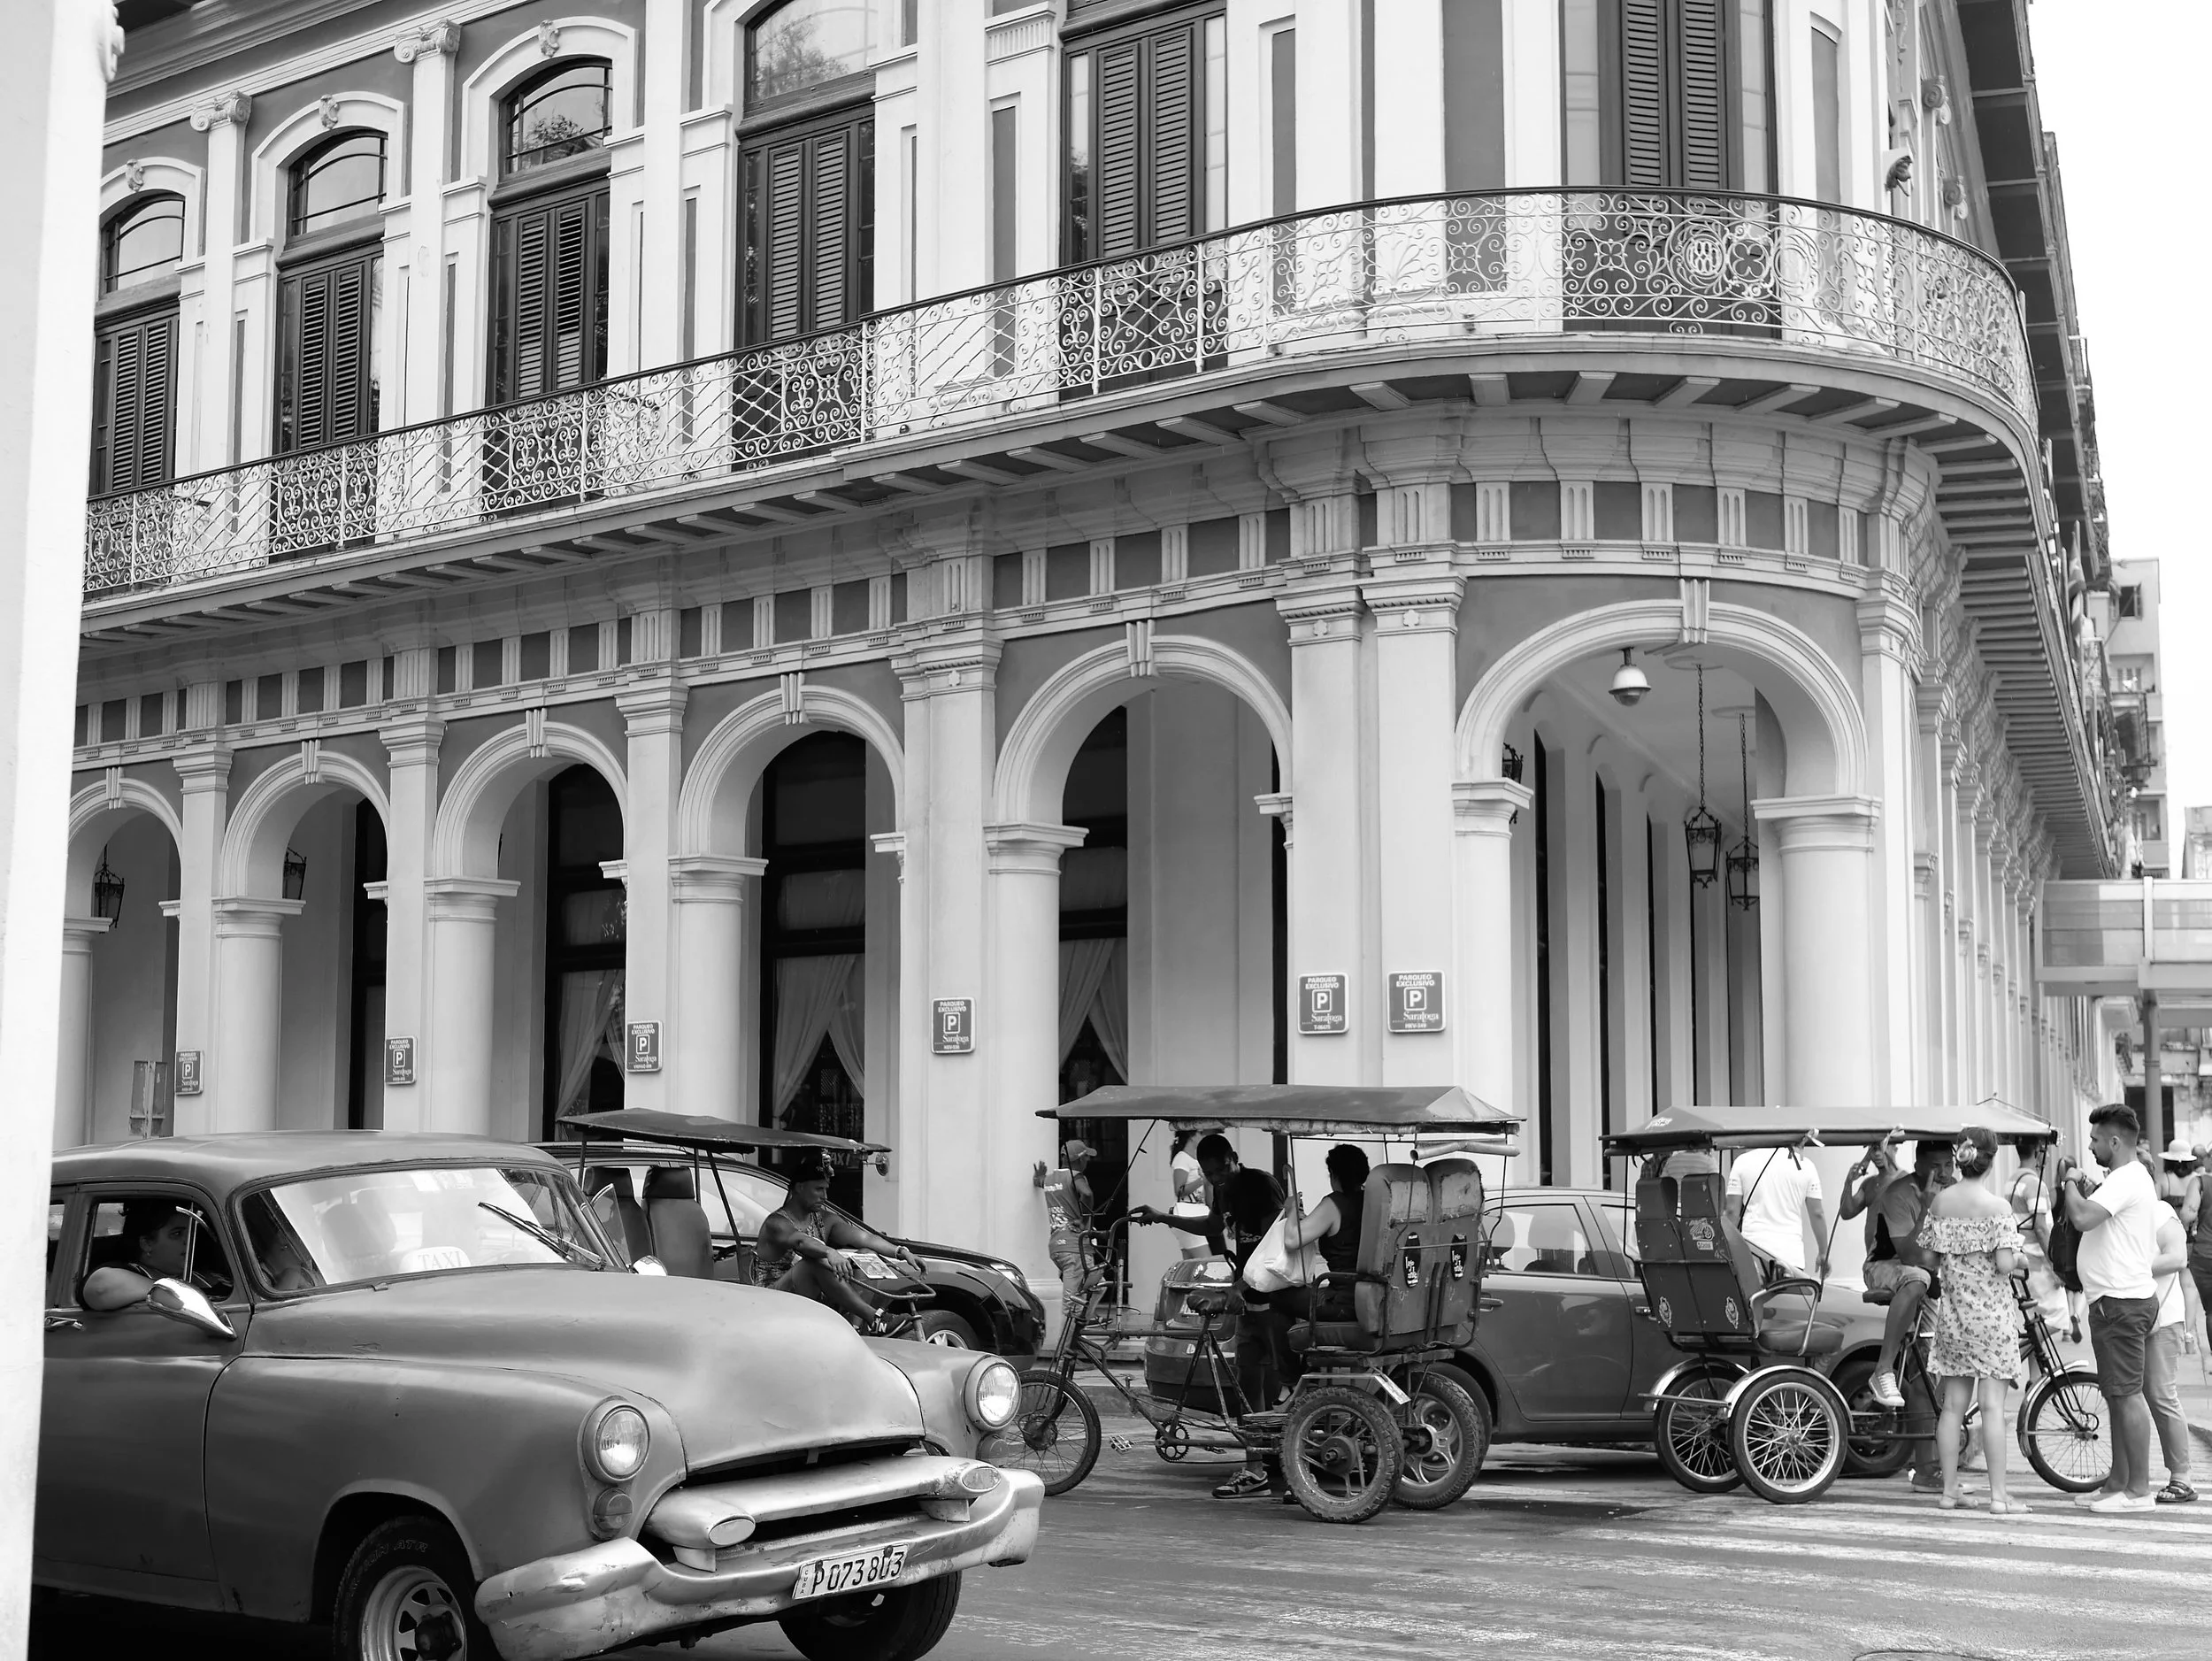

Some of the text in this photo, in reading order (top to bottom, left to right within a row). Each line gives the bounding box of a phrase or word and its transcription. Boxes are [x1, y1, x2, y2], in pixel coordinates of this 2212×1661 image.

[1317, 992, 1328, 1009] P
[1409, 990, 1422, 1007] P
[948, 1016, 956, 1031] P
[1311, 1012, 1343, 1024] Saratoga
[1403, 1011, 1440, 1023] Saratoga
[639, 1037, 647, 1051] P
[942, 1034, 969, 1044] Saratoga
[396, 1051, 403, 1065] P
[184, 1064, 191, 1076] P
[418, 1250, 462, 1270] TAXI
[800, 1570, 809, 1595] CUBA
